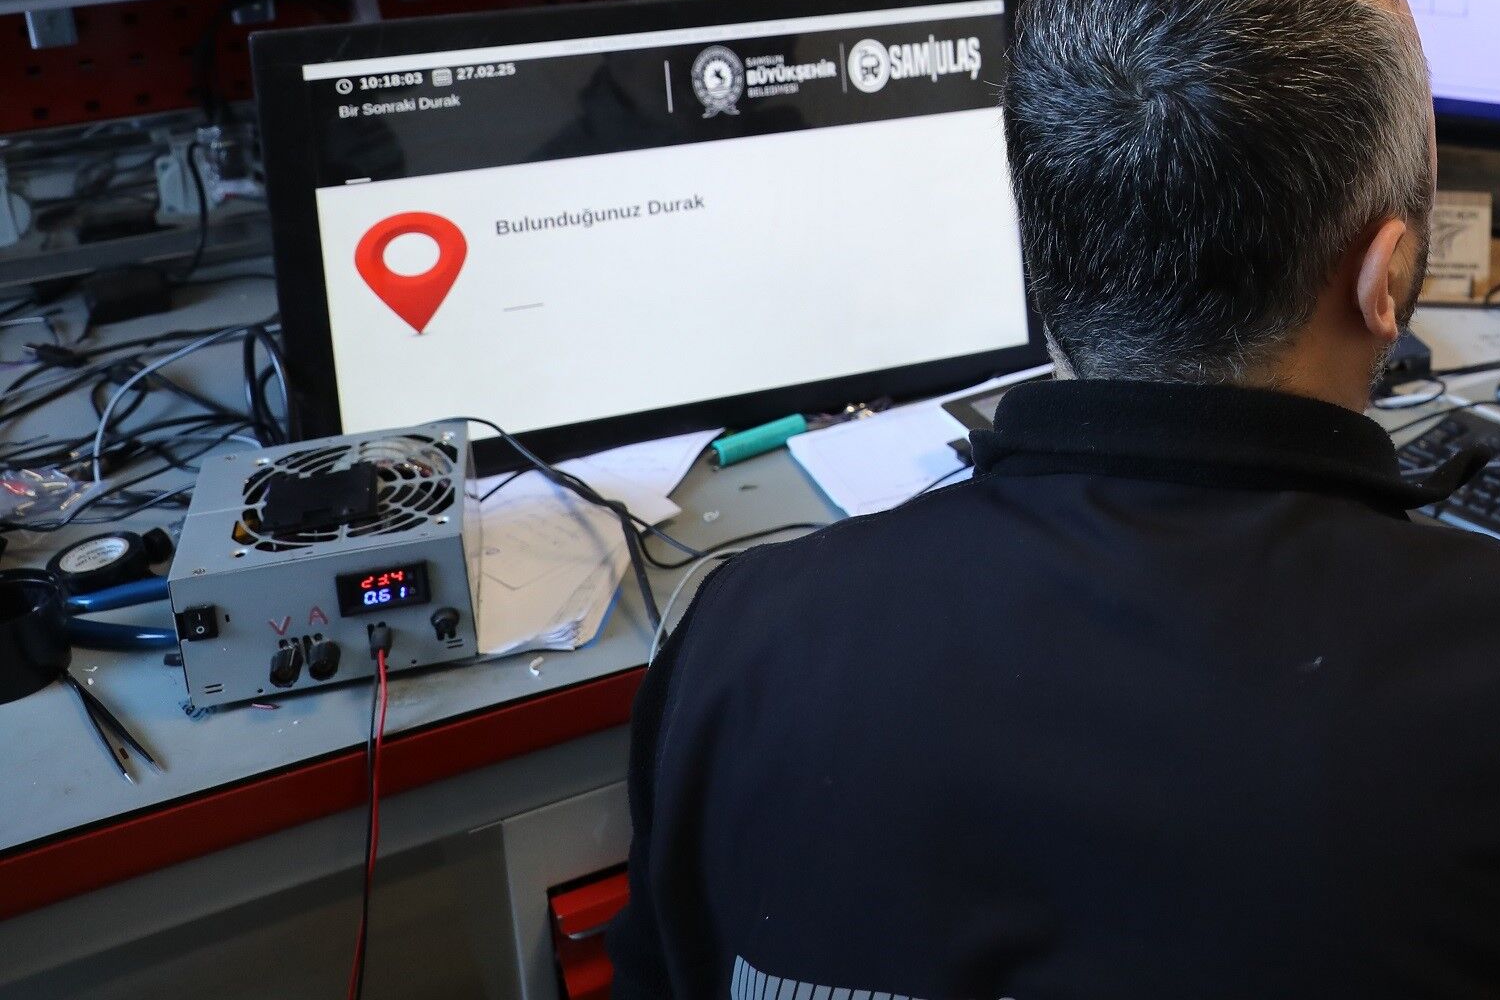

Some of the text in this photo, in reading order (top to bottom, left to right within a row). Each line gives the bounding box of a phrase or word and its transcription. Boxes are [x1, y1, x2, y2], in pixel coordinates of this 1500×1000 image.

[359, 62, 517, 91] 10:18:03 27.02.25
[338, 93, 462, 119] Bir Sonraki Durak
[495, 193, 705, 236] Bulunduğunuz Durak
[269, 605, 329, 636] V A
